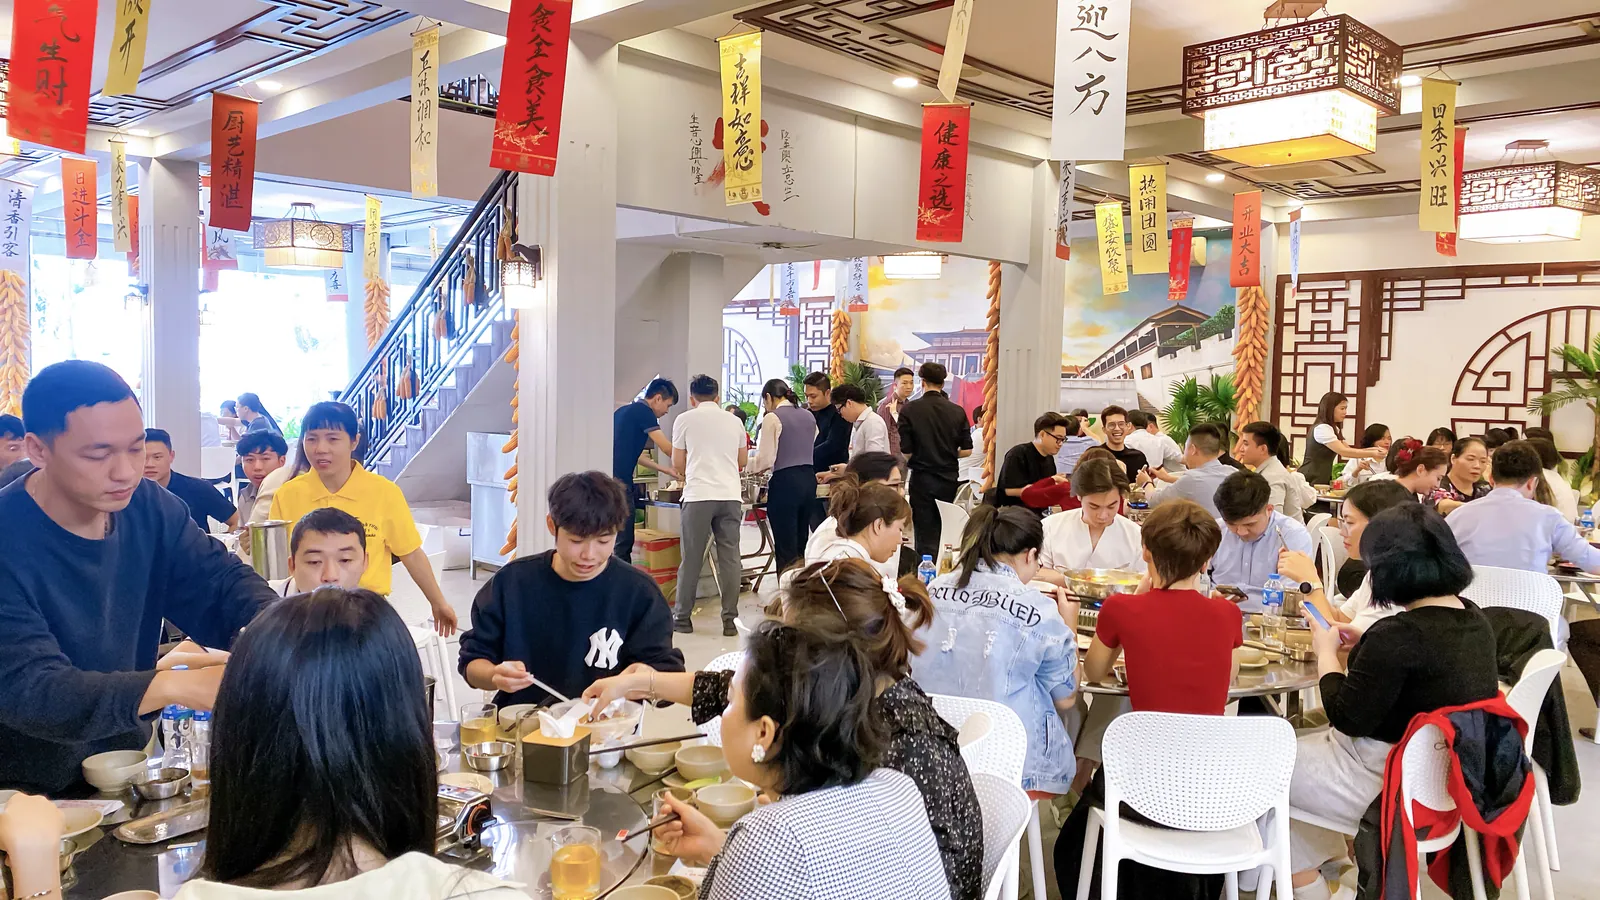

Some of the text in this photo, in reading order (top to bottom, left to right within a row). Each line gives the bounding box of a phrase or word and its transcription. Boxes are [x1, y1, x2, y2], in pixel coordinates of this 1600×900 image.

[518, 3, 555, 136] 食全食美
[727, 53, 754, 171] 吉祥如意
[221, 110, 245, 209] 厨艺精湛
[928, 120, 960, 211] 健康之选
[1429, 103, 1449, 207] 四季兴旺
[2, 188, 27, 257] 清香引客
[72, 172, 92, 249] 日进斗金
[1139, 174, 1156, 253] 热闹团圆
[1238, 204, 1255, 277] 开业大吉
[584, 627, 624, 670] NY
